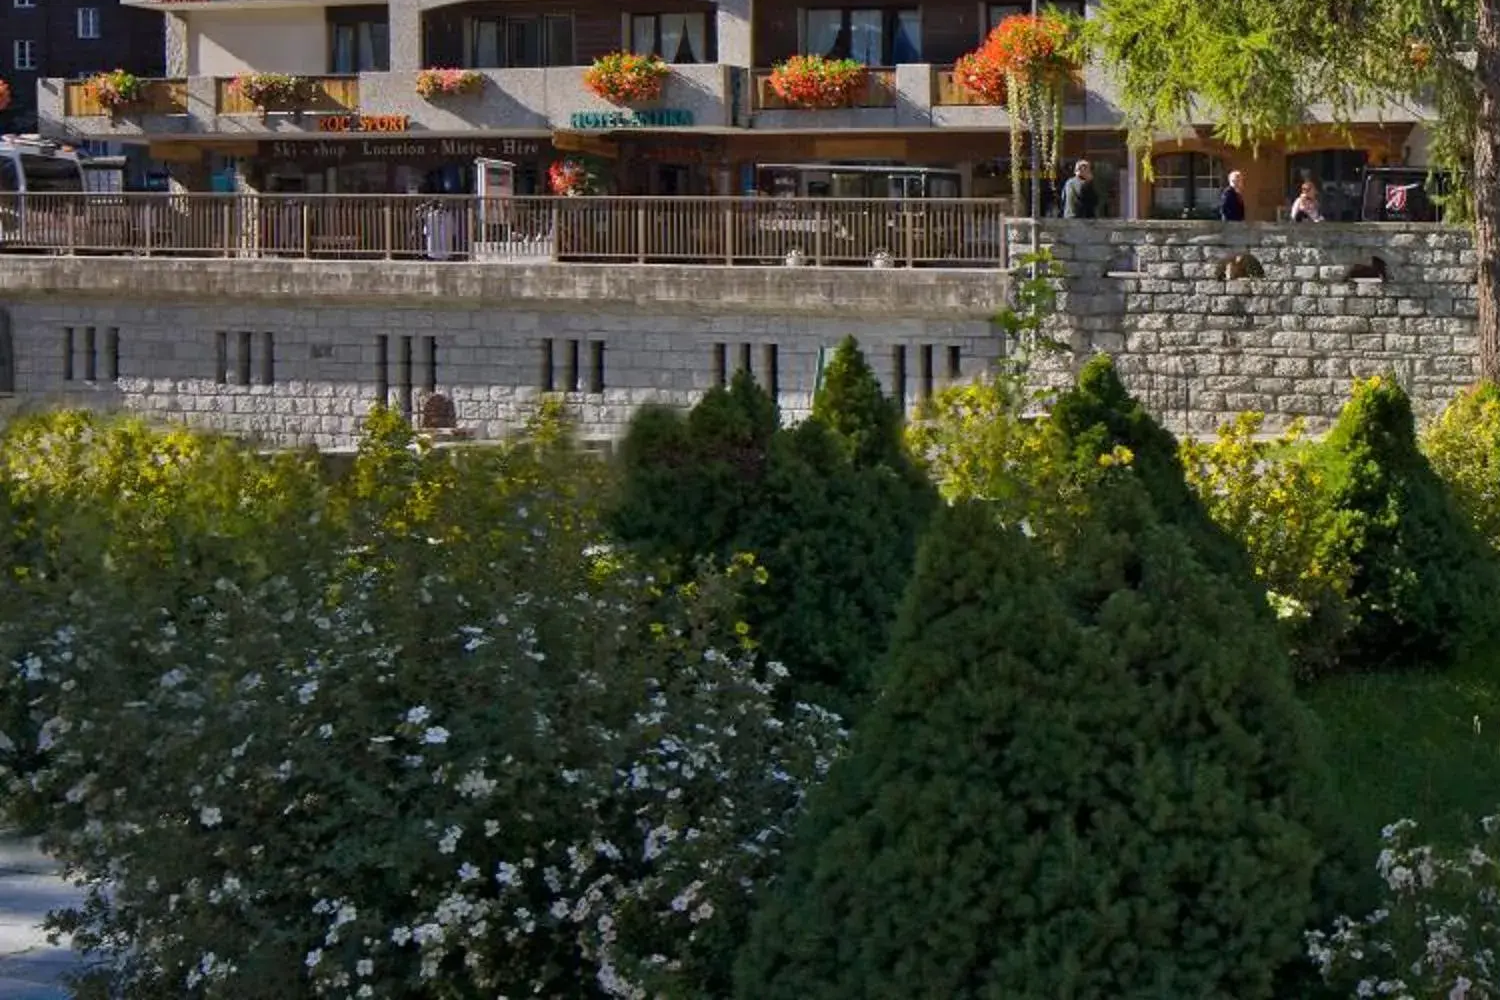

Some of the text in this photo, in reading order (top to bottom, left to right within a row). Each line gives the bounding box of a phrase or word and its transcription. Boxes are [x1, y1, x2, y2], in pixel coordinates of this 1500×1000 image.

[360, 114, 408, 132] SPORT
[362, 141, 426, 155] Location
[441, 140, 484, 155] Miete
[503, 139, 539, 155] Hire
